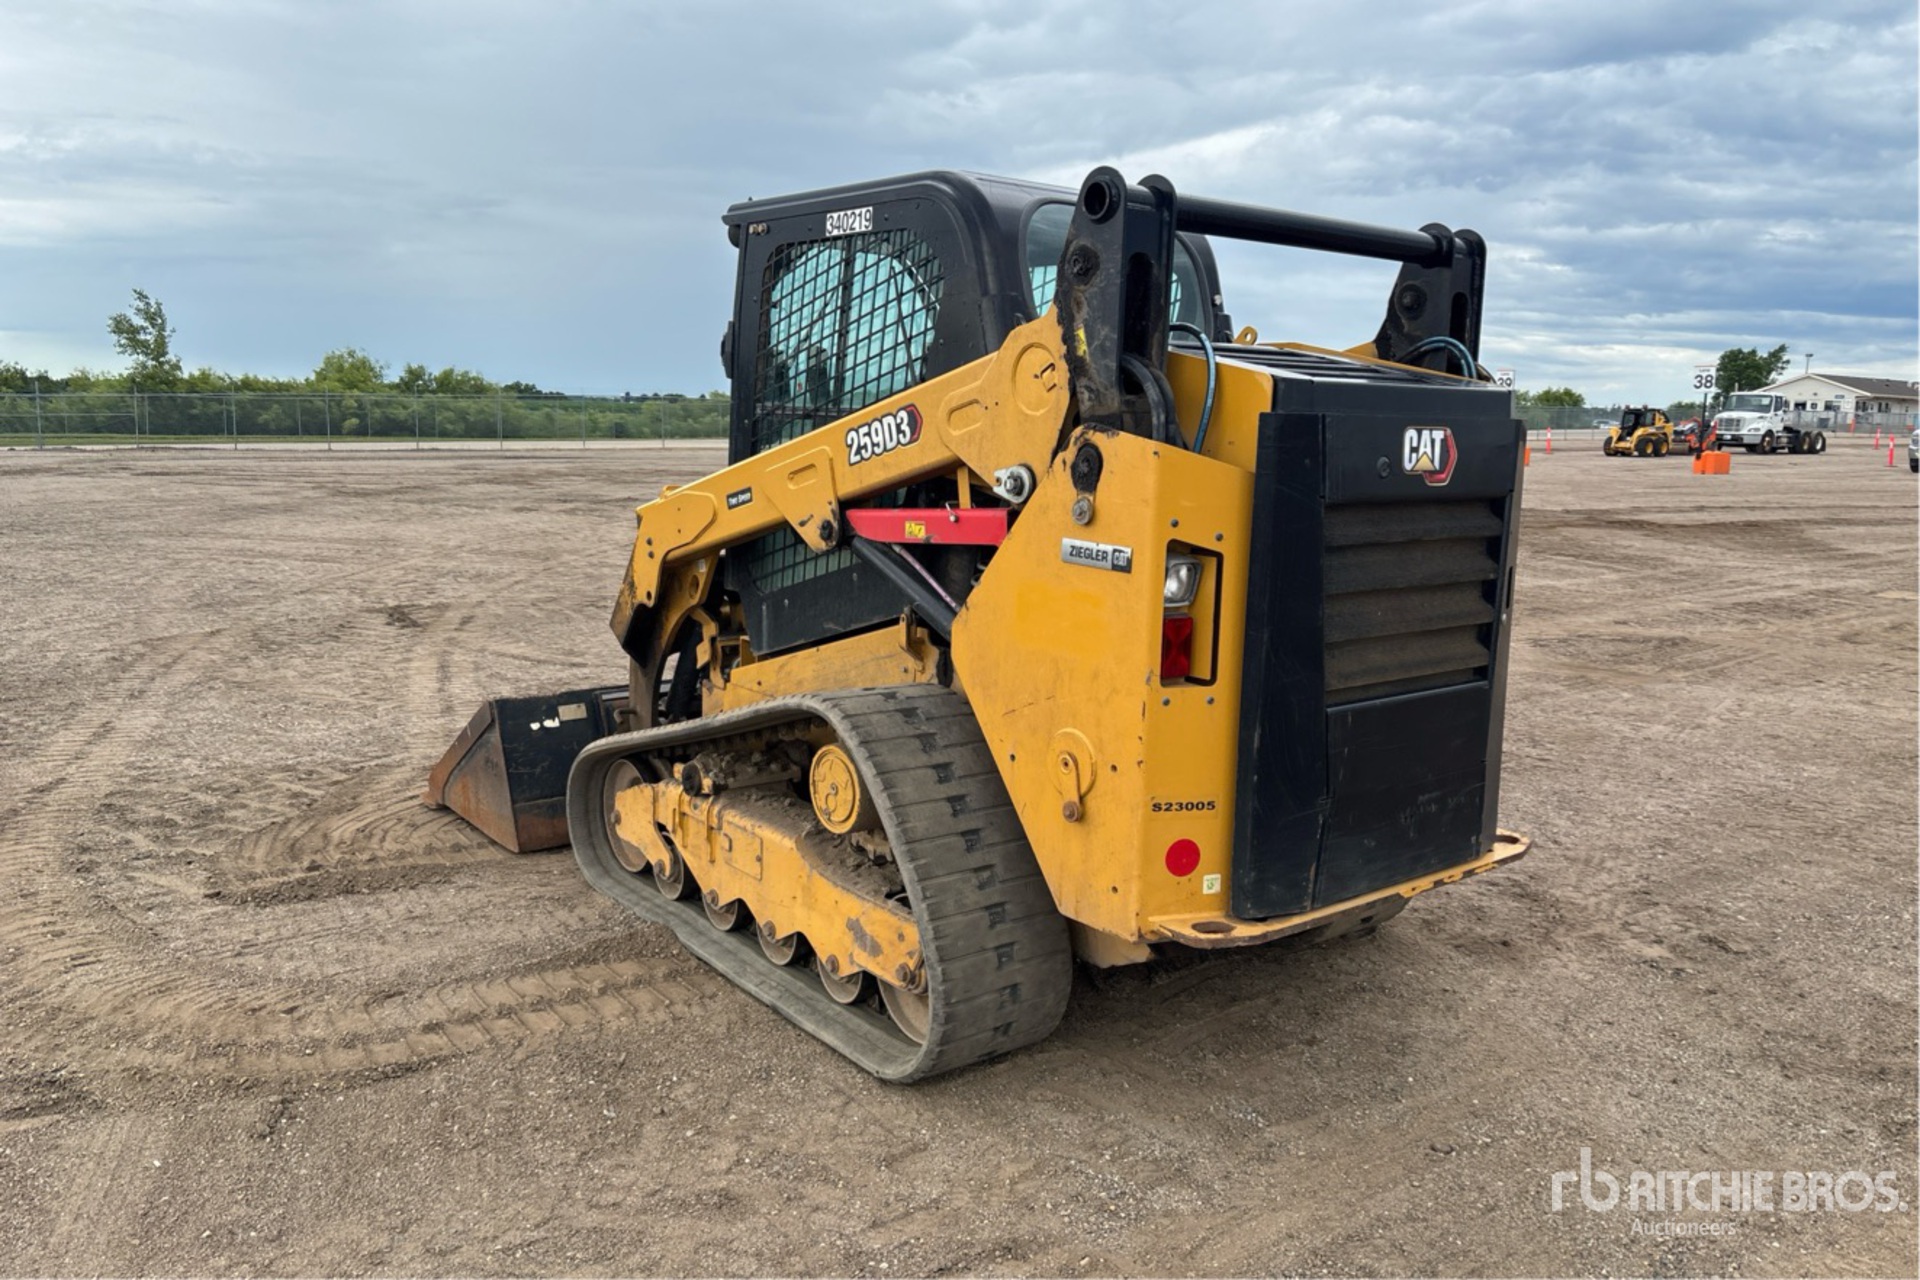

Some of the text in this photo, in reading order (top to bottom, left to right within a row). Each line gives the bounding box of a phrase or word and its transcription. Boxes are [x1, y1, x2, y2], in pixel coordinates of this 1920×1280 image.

[827, 209, 872, 235] 340219
[1694, 374, 1713, 389] 38
[846, 409, 911, 464] 259D3
[1403, 428, 1445, 471] CAT
[1069, 545, 1108, 563] ZIEGLER
[1152, 801, 1216, 812] S23005
